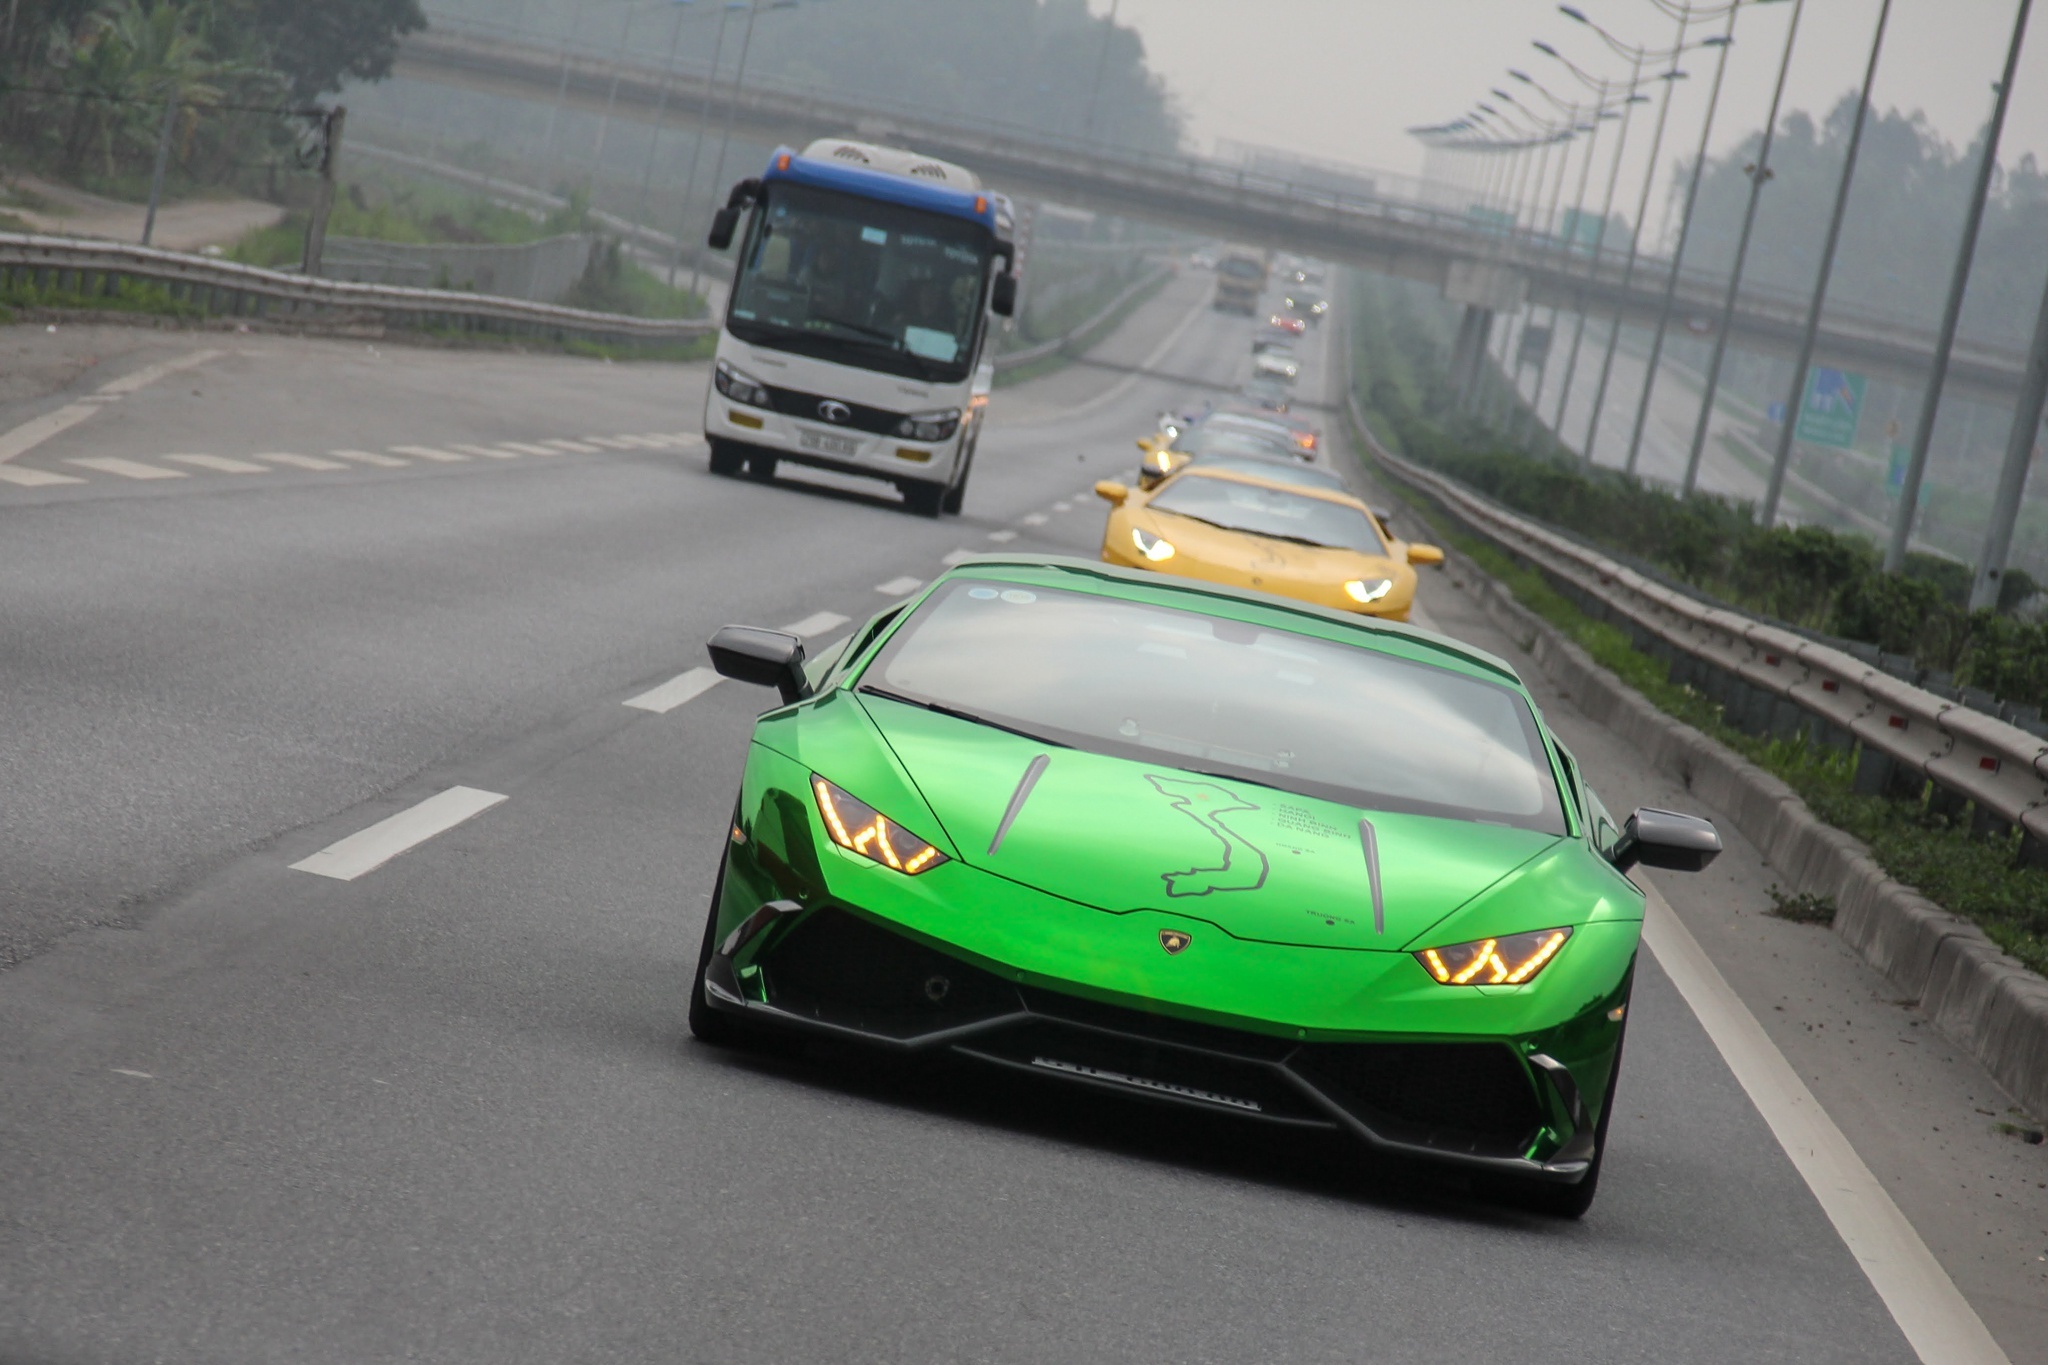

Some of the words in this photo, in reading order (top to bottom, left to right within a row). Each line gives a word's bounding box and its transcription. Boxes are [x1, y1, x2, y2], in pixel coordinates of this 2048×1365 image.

[1279, 813, 1306, 823] NINH
[1277, 822, 1293, 830] DA
[1278, 818, 1320, 831] QUANG
